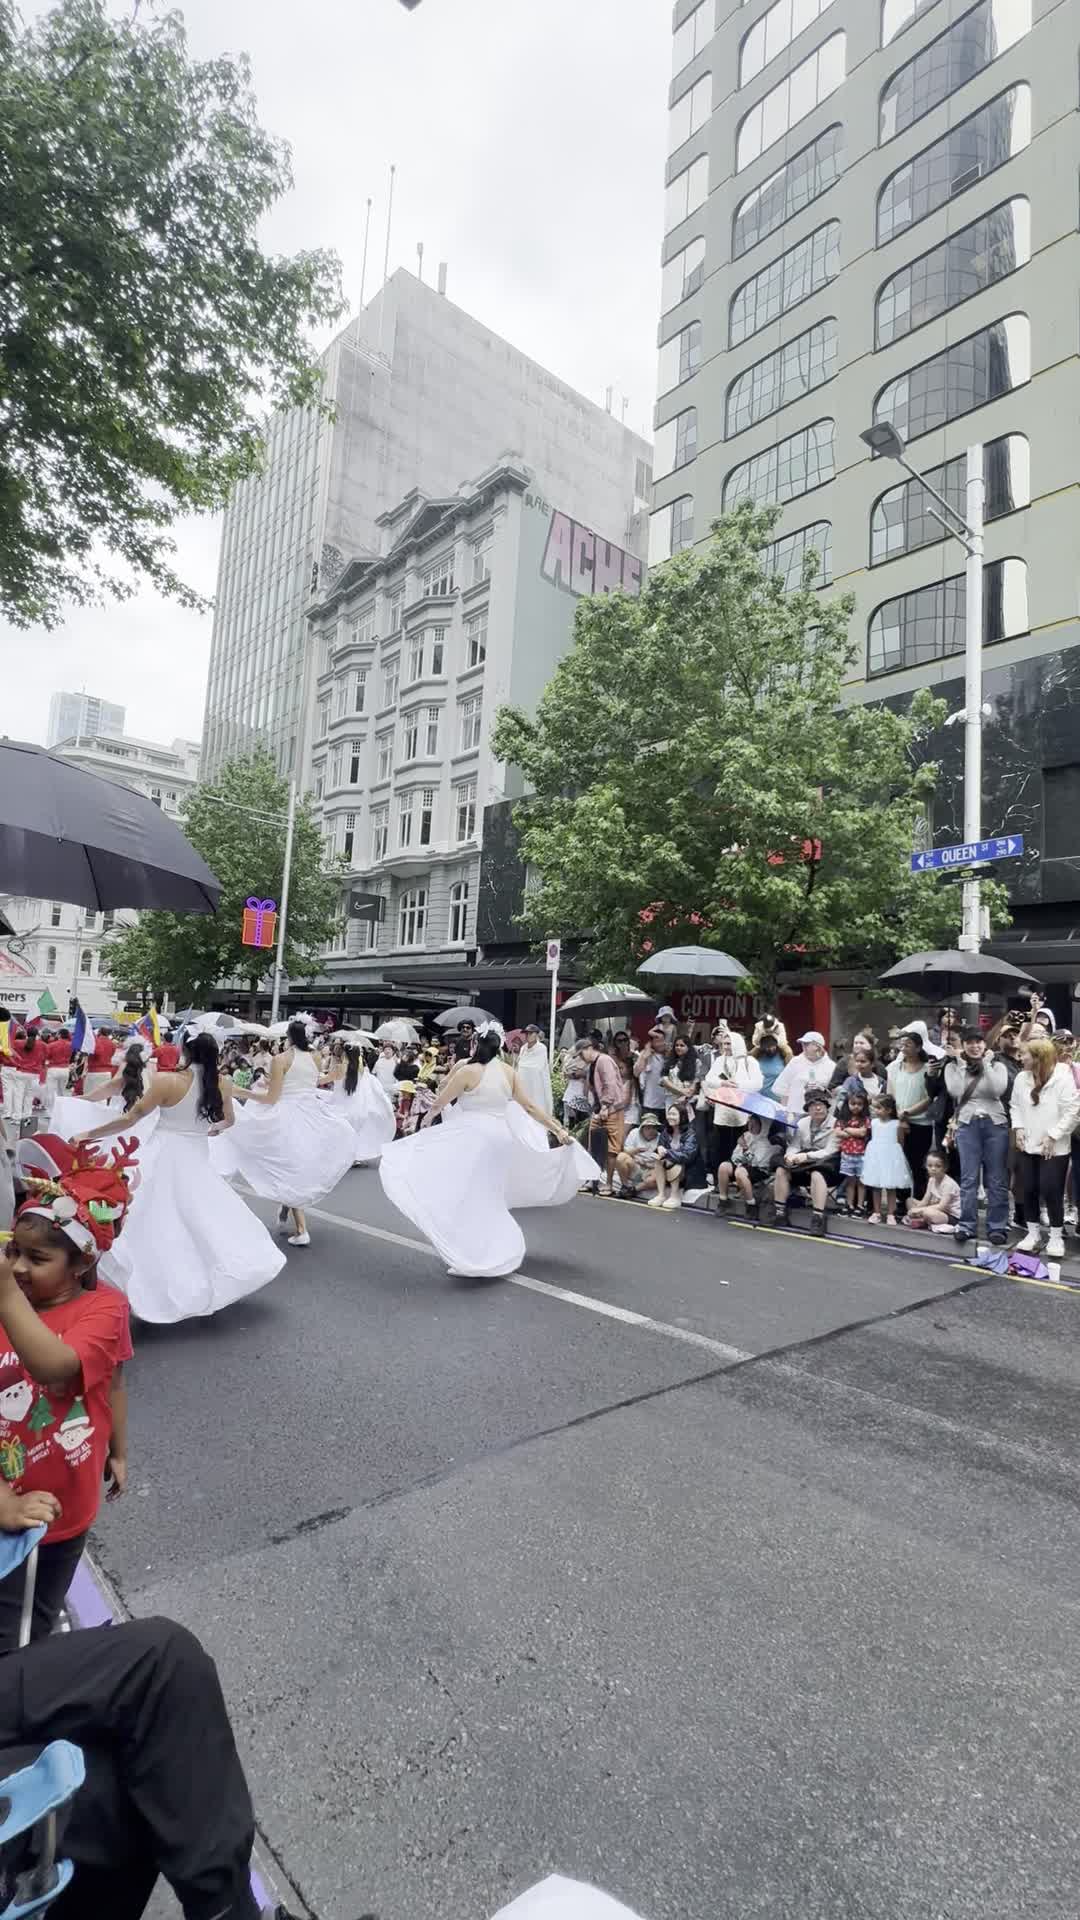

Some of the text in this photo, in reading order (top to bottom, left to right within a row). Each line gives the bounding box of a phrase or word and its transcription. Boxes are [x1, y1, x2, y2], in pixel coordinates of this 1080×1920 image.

[941, 846, 977, 864] QUEEN
[981, 843, 989, 852] ST
[681, 994, 746, 1018] COTTON
